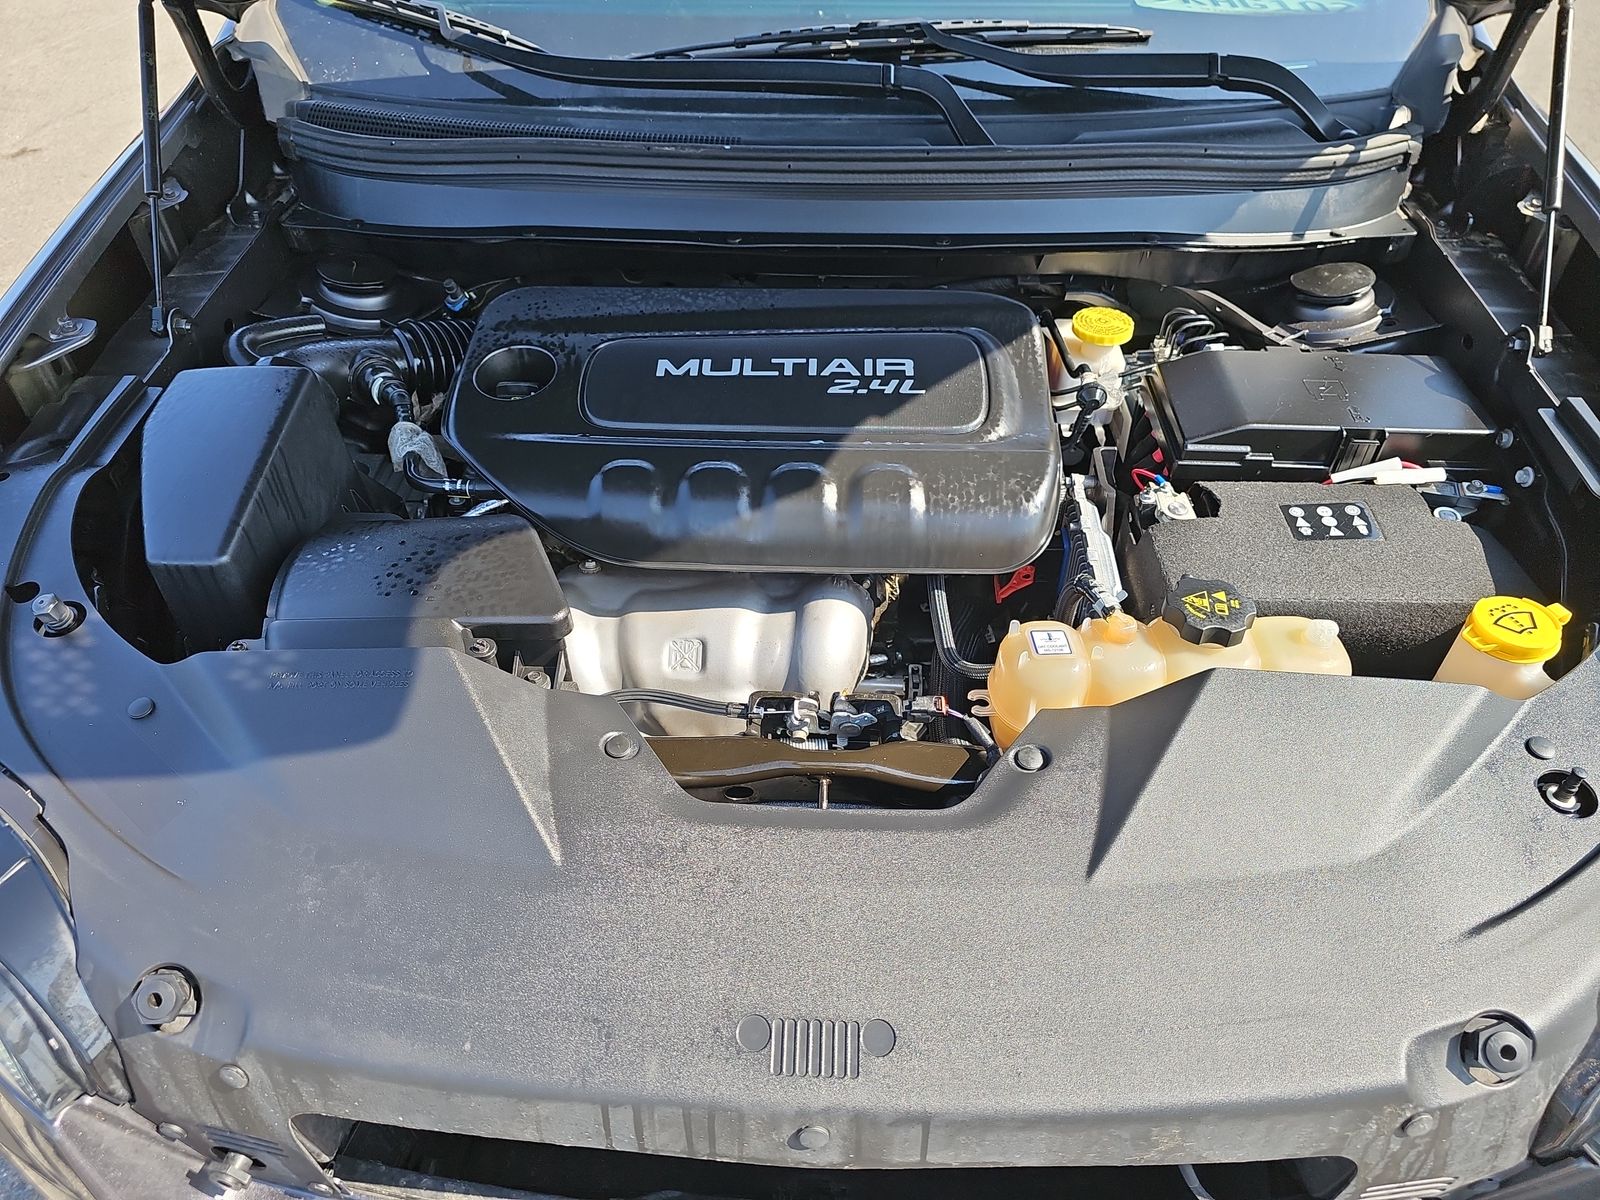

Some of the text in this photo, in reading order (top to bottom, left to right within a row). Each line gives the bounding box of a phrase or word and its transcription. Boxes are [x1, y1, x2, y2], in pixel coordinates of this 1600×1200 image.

[655, 358, 915, 377] MULTIAIR
[826, 379, 927, 395] 2.4L
[370, 670, 401, 678] ACCESS
